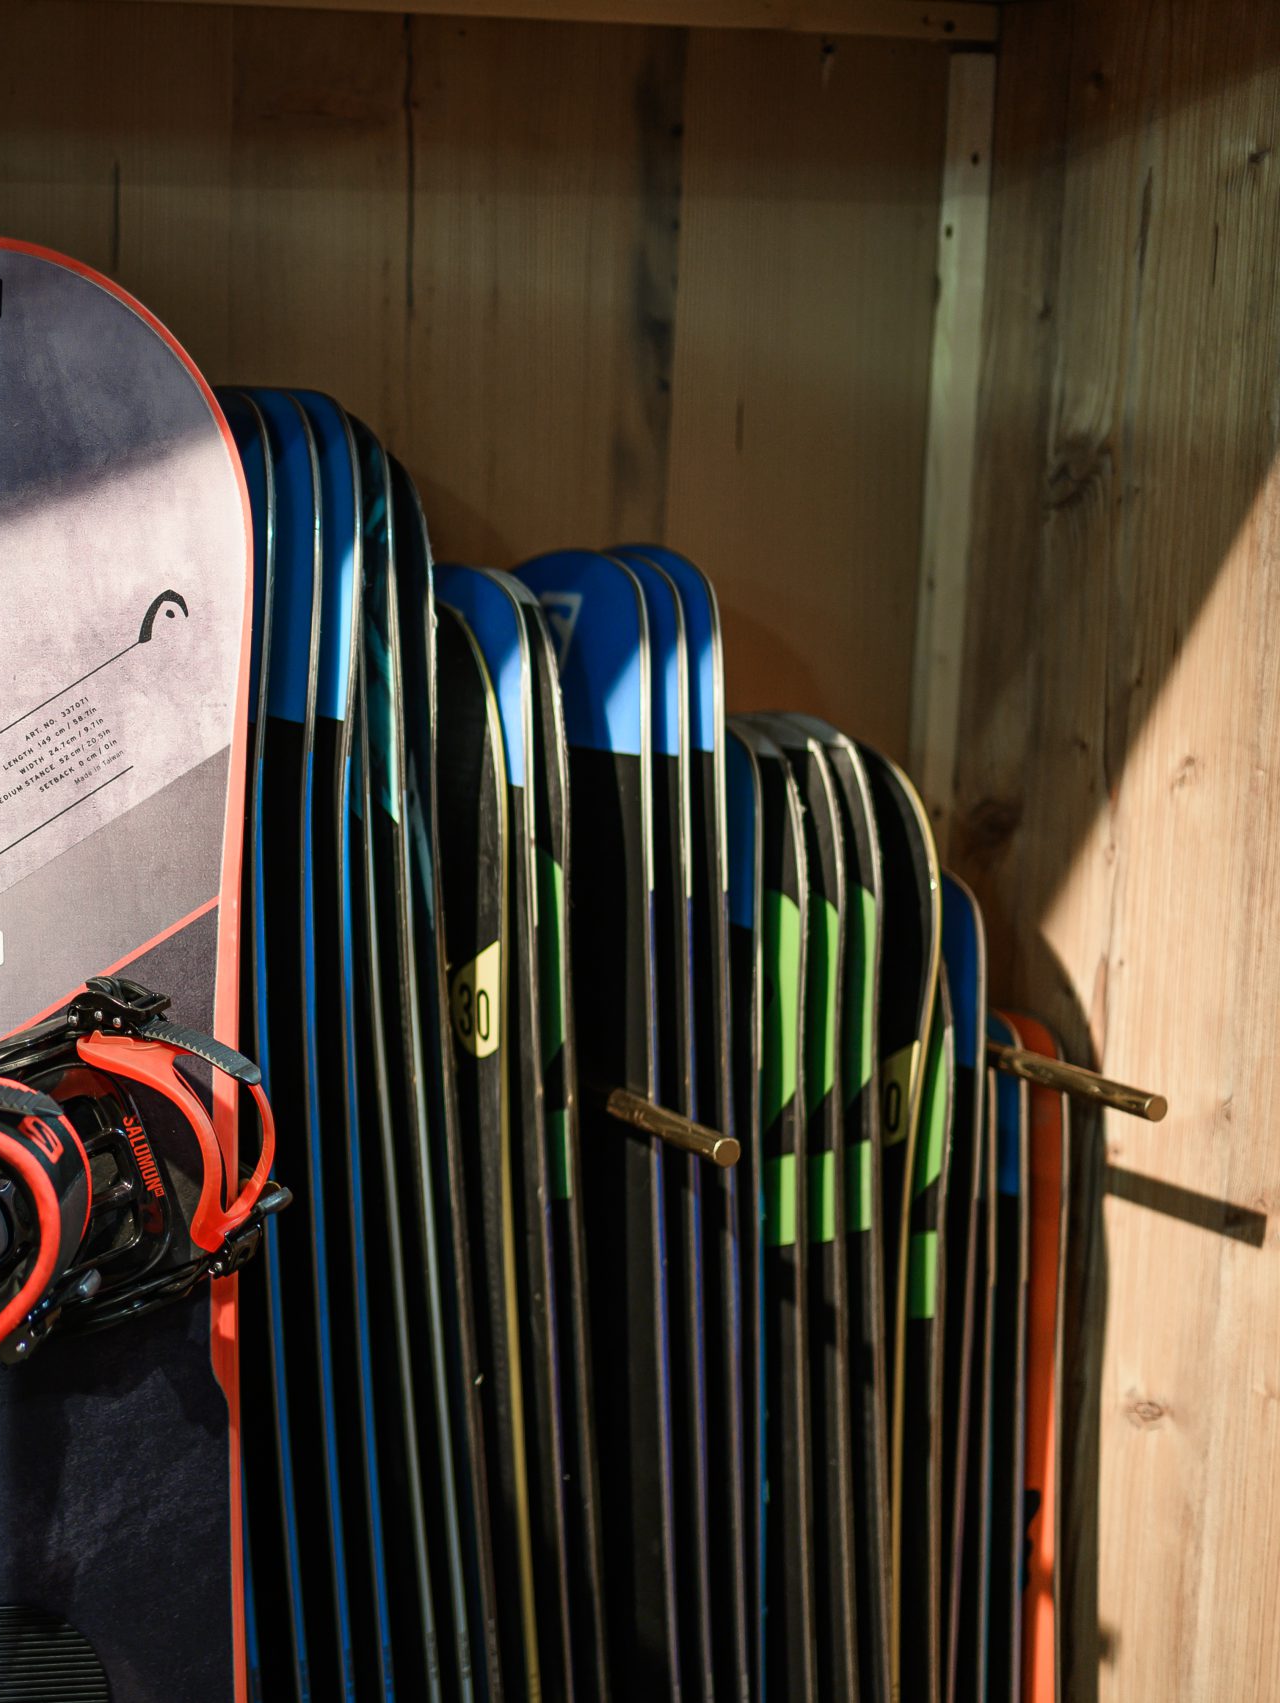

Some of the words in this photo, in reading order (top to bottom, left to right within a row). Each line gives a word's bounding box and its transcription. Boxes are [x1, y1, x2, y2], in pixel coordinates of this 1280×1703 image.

[24, 726, 42, 741] ART.
[61, 697, 89, 718] 337071
[3, 748, 34, 771] LENGTH
[37, 736, 51, 748] 149
[55, 728, 65, 737] cm
[20, 757, 45, 775] WIDTH
[74, 770, 93, 785] Made
[102, 750, 124, 767] Taiwan
[25, 765, 56, 787] STANCE
[39, 767, 75, 793] SETBACK
[87, 753, 97, 762] cm
[459, 983, 490, 1042] 30
[122, 1116, 161, 1194] SALOMON
